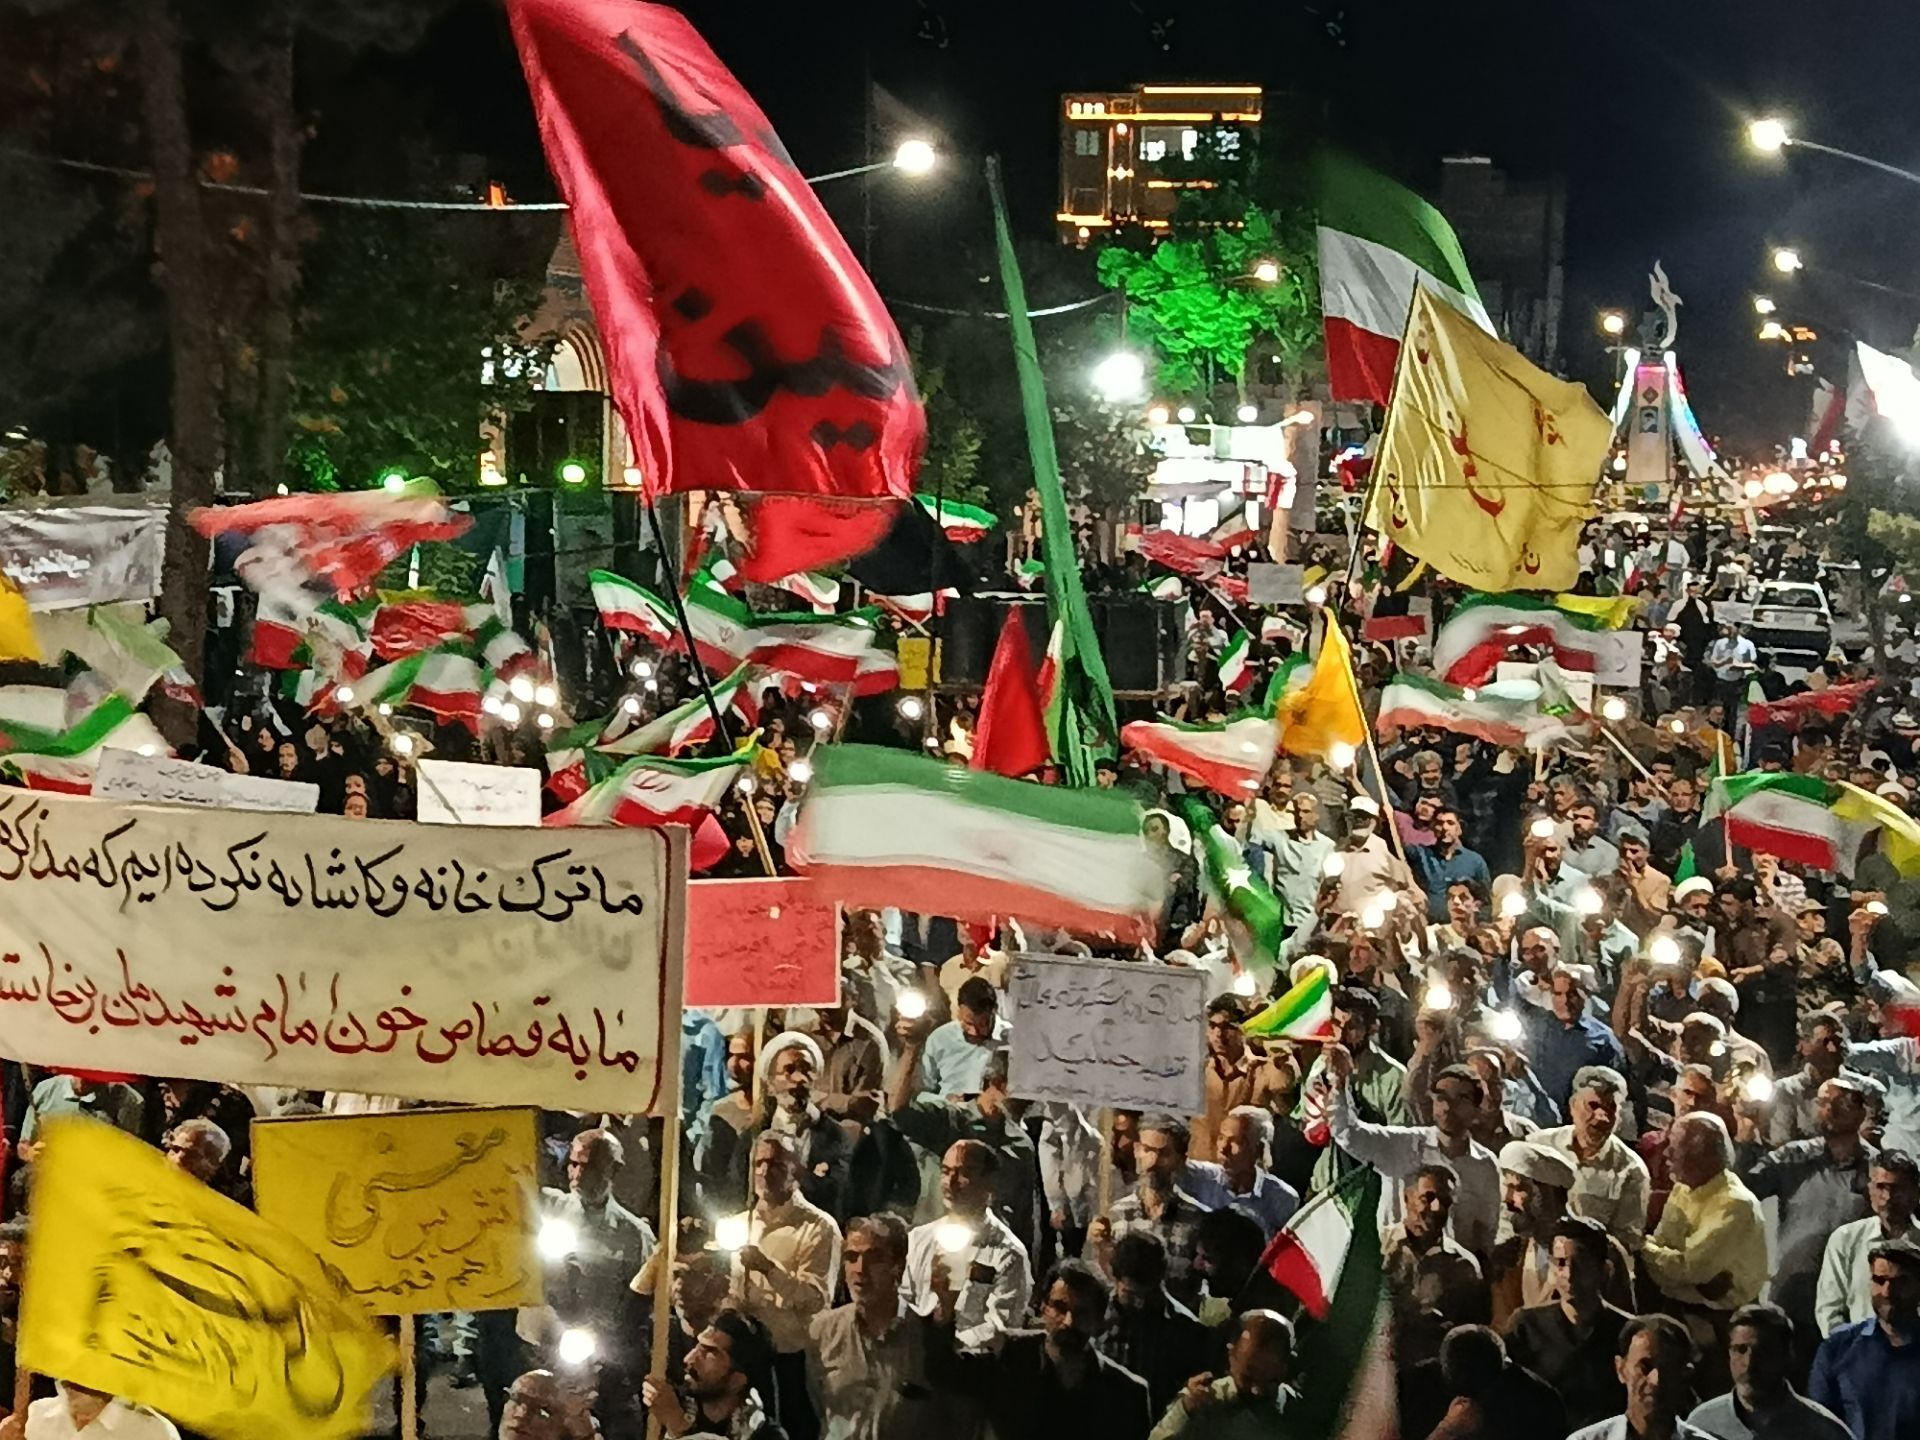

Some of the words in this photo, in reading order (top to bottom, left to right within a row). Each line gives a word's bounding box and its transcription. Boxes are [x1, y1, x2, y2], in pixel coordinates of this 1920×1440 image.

[82, 818, 138, 888] که
[414, 859, 493, 914] خانه
[498, 848, 591, 922] ترک
[591, 865, 644, 915] ما
[253, 970, 340, 1062] امام
[324, 984, 428, 1054] خون
[416, 995, 552, 1064] قصاص
[547, 1012, 591, 1081] به
[593, 1007, 641, 1073] ما
